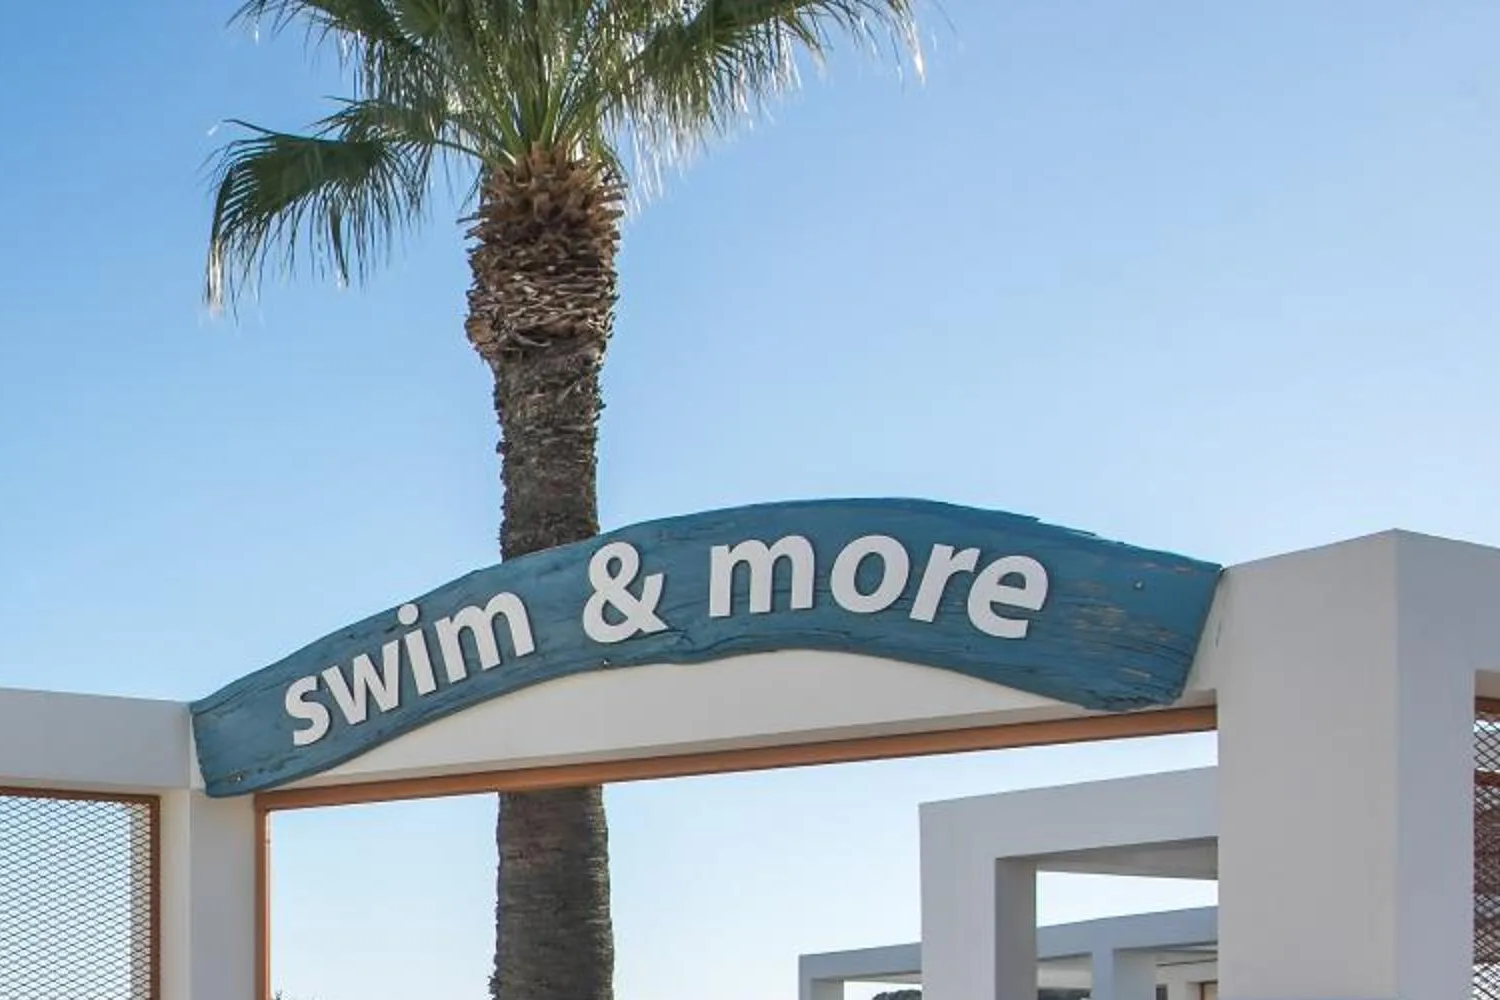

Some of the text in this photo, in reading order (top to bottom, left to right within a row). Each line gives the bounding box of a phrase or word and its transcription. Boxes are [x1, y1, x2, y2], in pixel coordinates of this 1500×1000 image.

[284, 534, 1050, 747] swim & more
